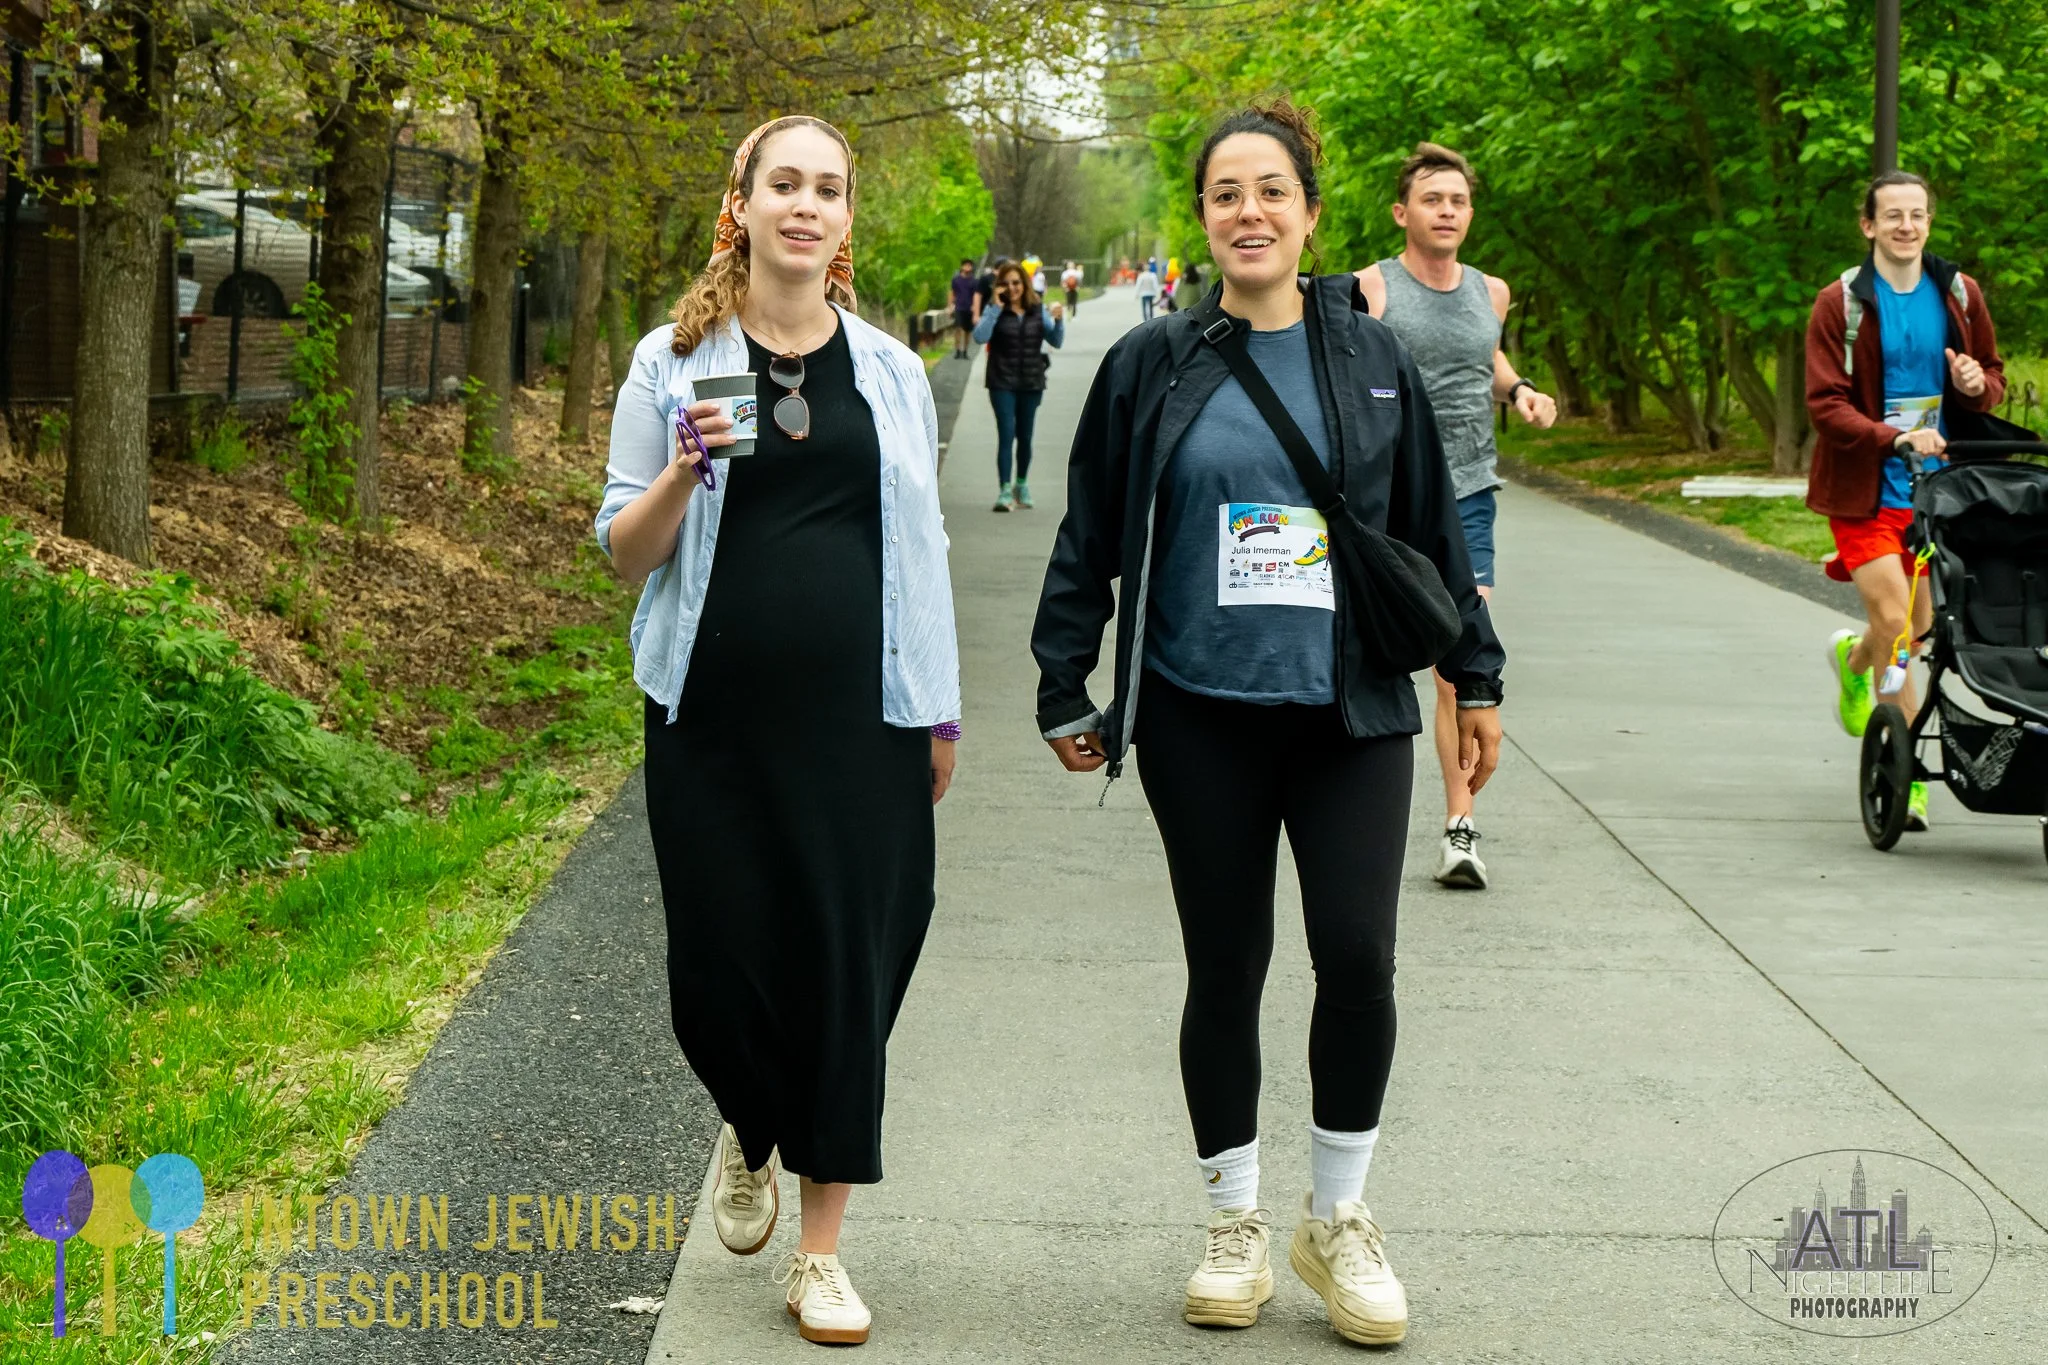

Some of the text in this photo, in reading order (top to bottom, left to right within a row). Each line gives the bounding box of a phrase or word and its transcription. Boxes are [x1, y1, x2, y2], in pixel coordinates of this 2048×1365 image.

[1228, 512, 1289, 535] FUN RUN
[1231, 546, 1291, 555] Julia Imerman
